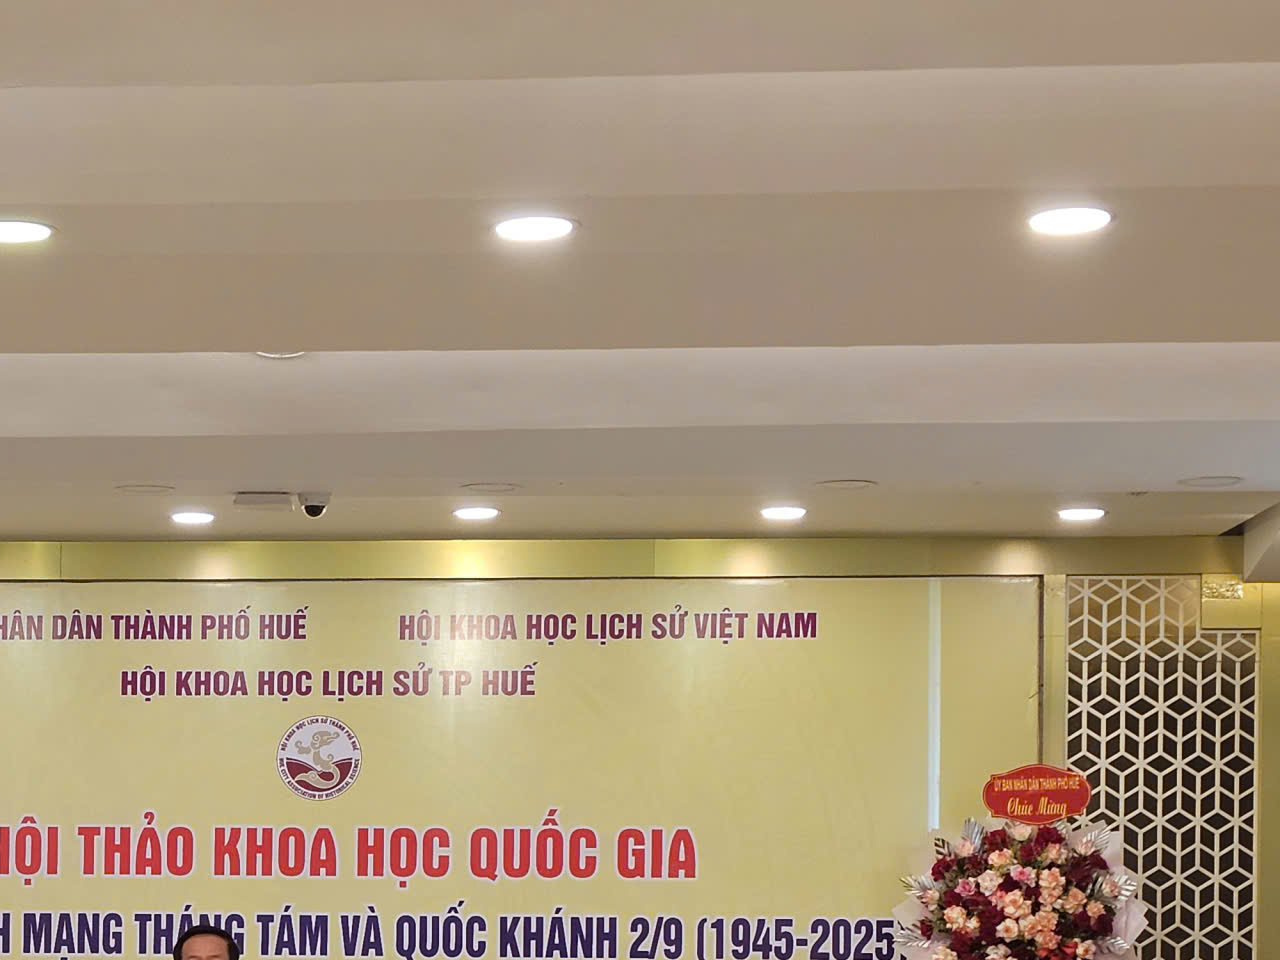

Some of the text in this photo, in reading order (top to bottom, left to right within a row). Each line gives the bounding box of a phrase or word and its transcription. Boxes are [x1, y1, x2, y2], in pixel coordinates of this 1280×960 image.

[53, 610, 102, 639] DÂN
[111, 610, 191, 639] THÀNH
[201, 606, 250, 639] PHỐ
[260, 606, 309, 639] HUẾ
[400, 605, 816, 645] HỘI KHOA HỌC LỊCH SỬ VIỆT NAM
[122, 662, 538, 701] HỘI KHOA HỌC LỊCH SỬ TP HUẾ
[1007, 797, 1033, 816] Chúc
[78, 812, 193, 876] THẢO
[214, 828, 336, 876] KHOA
[357, 828, 449, 888] HỌC
[470, 809, 596, 881] QUỐC
[618, 829, 695, 878] GIA
[257, 906, 328, 956] TÁM
[341, 907, 383, 956] VÀ
[396, 900, 486, 959] QUỐC
[500, 908, 616, 958] KHÁNH
[630, 917, 682, 959] 2/9
